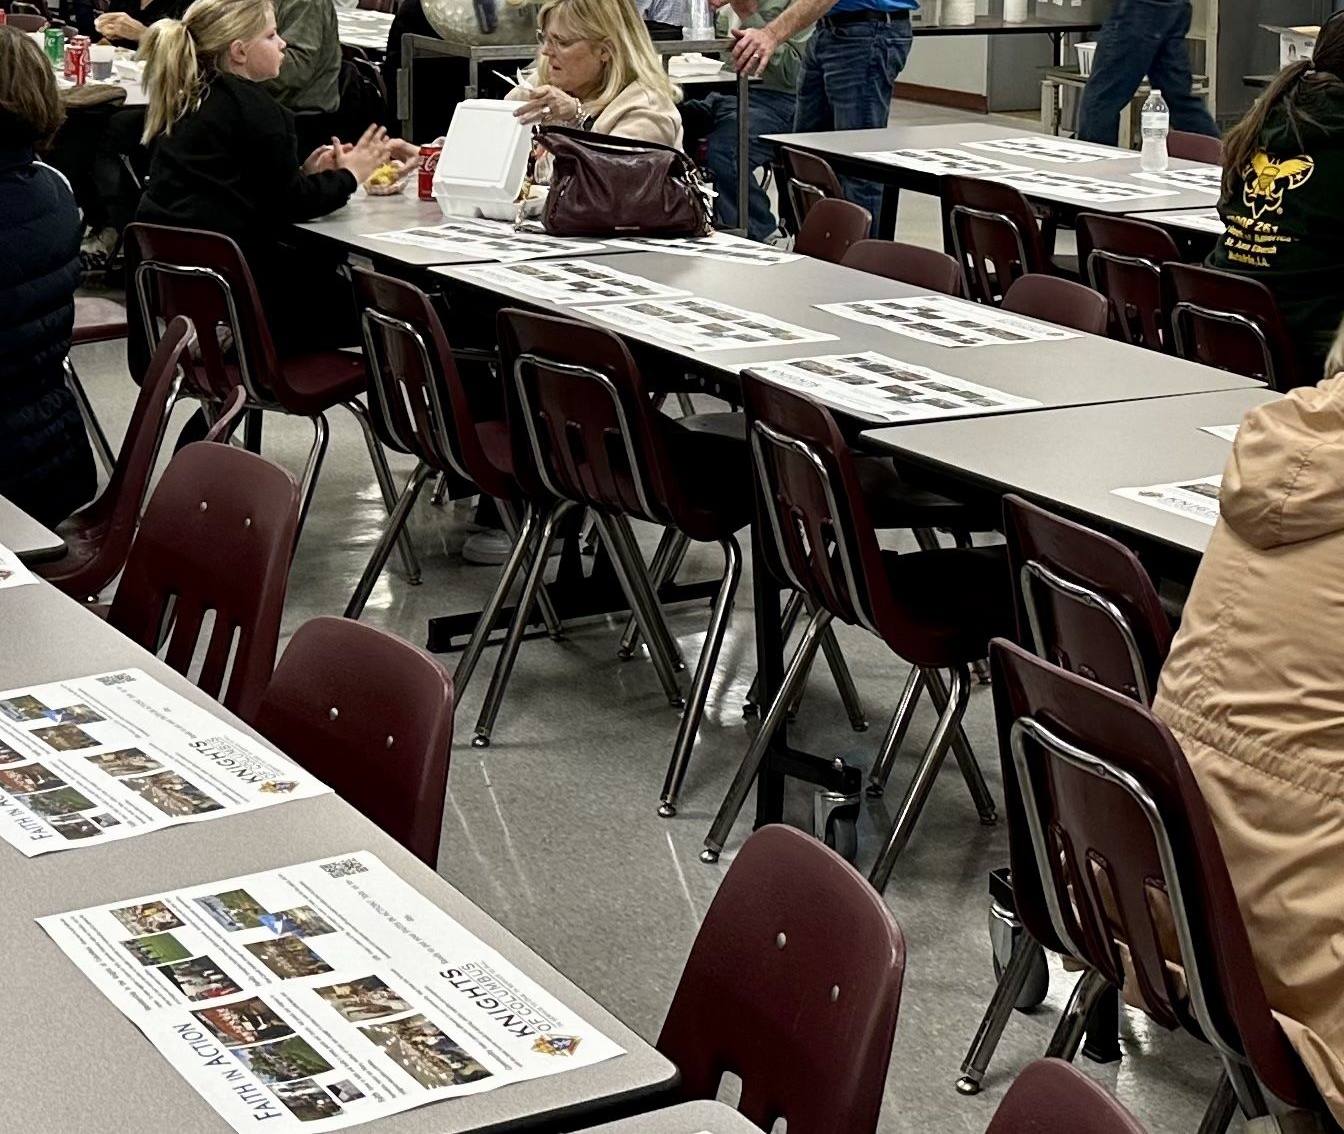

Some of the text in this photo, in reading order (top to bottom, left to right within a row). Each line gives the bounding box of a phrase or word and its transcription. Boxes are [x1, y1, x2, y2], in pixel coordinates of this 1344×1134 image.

[183, 739, 267, 784] KNIGHTS
[4, 807, 26, 816] IN
[9, 816, 54, 840] FAITH
[436, 967, 538, 1038] KNIGHTS
[458, 962, 555, 1032] OF COLUMBUS
[165, 1022, 233, 1069] ACTION
[219, 1068, 246, 1081] IN
[225, 1082, 284, 1121] FAITH
